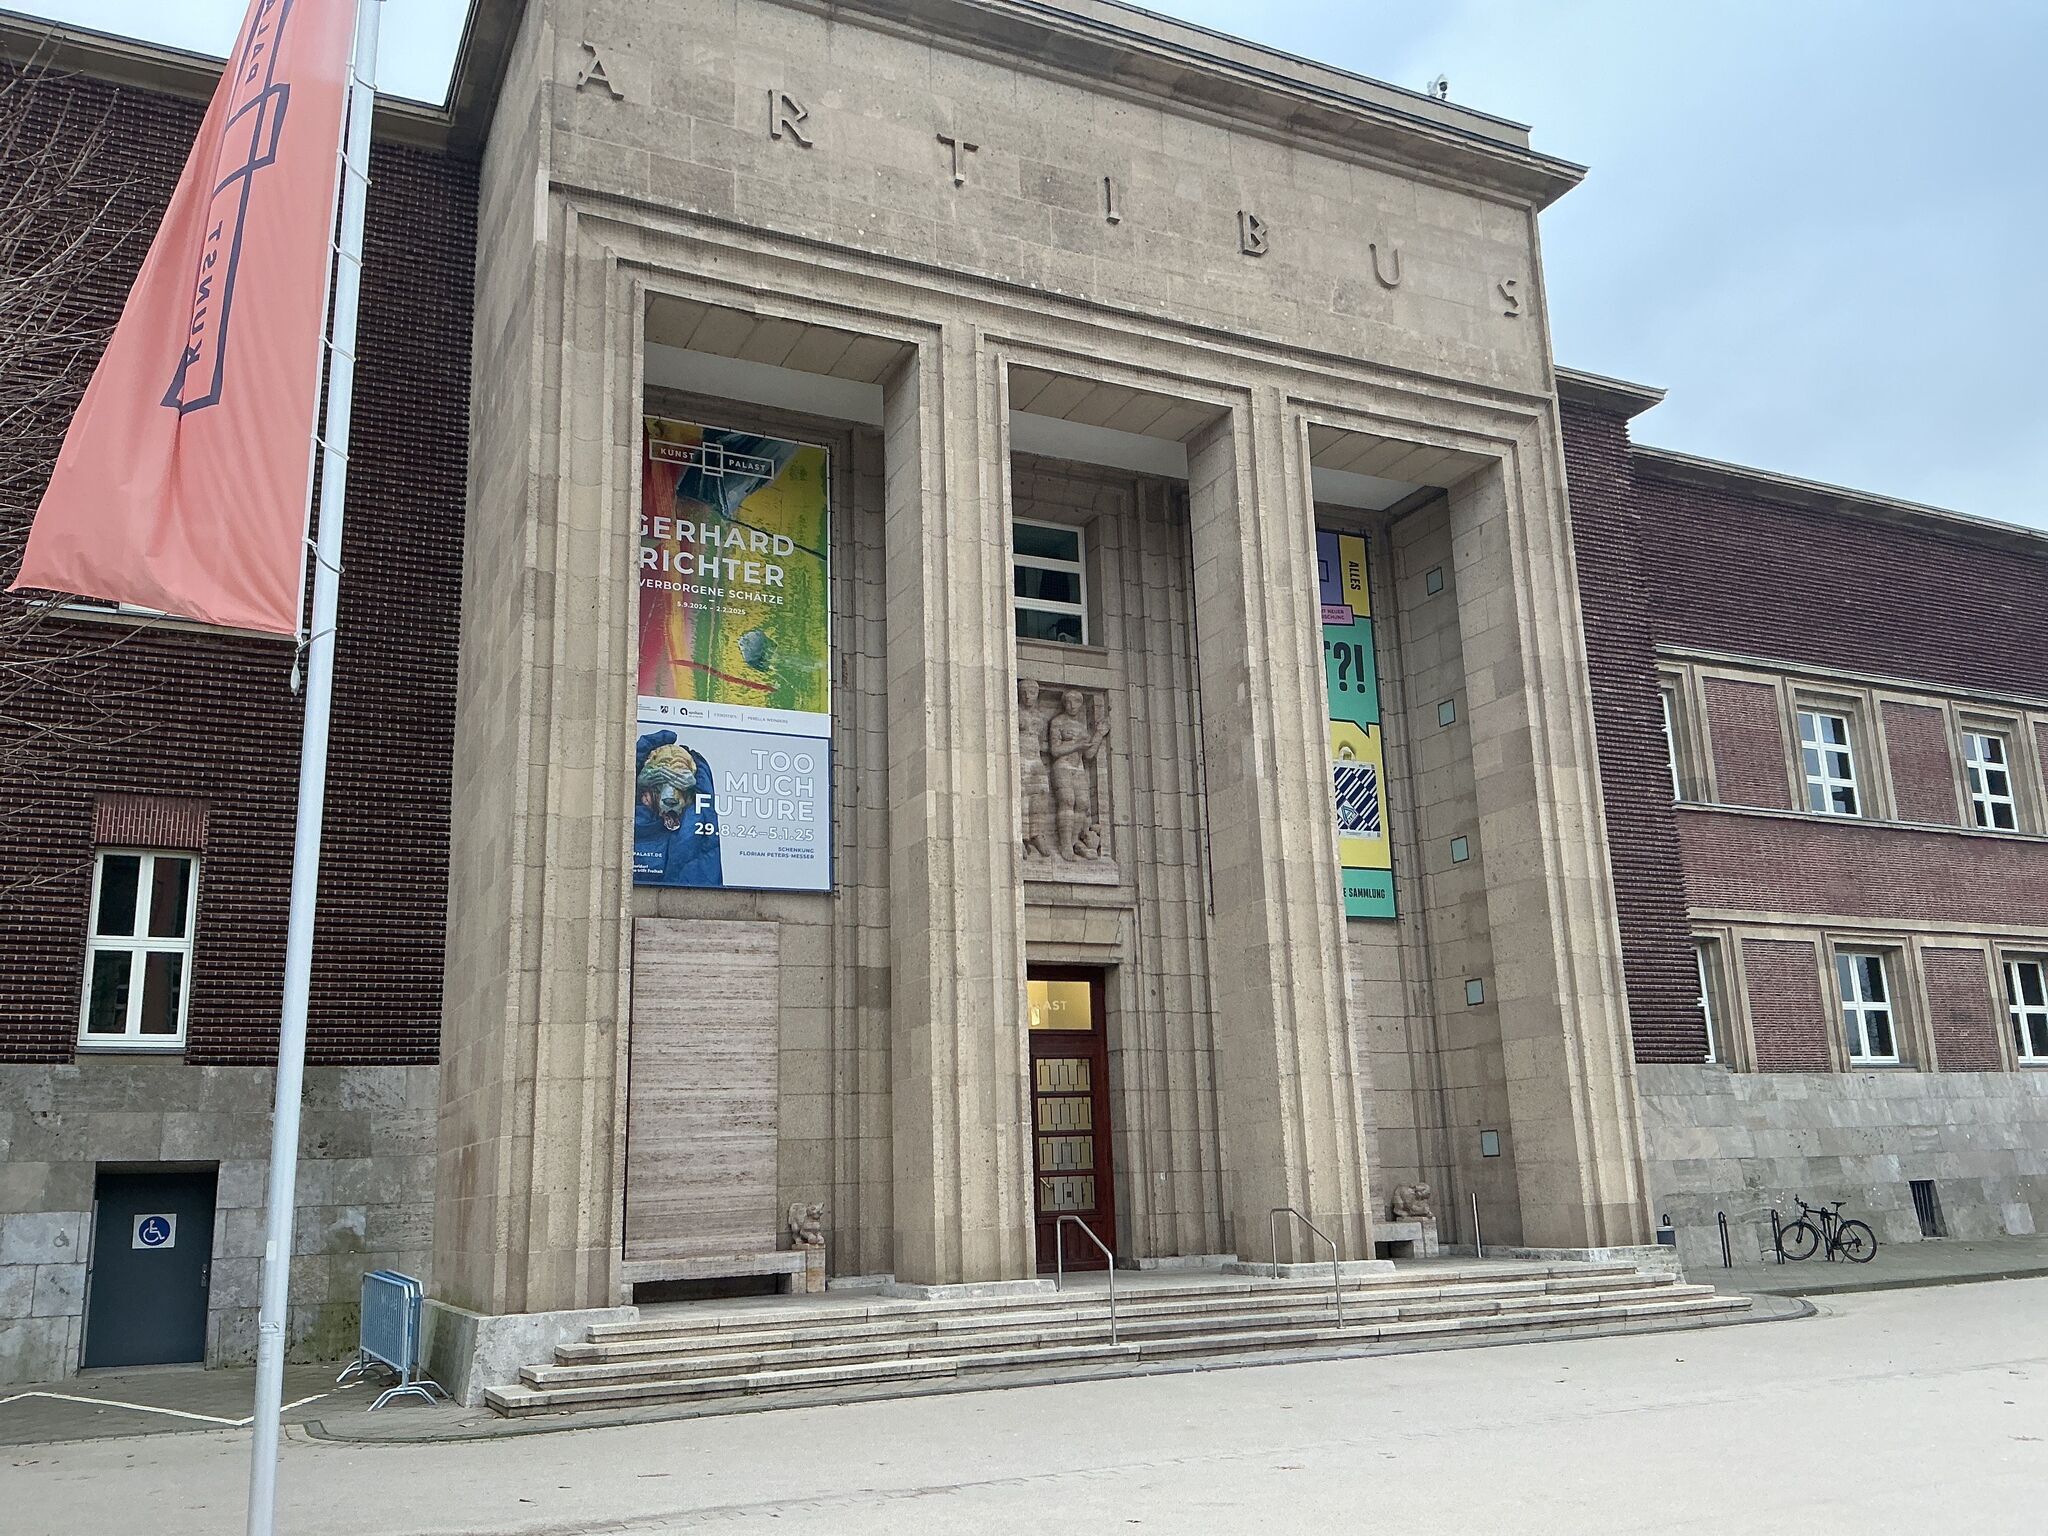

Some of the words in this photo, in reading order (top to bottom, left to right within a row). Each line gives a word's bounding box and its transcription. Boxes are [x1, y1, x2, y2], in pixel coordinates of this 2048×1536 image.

[577, 40, 1520, 318] ARTIBUS
[660, 447, 695, 460] KUNST
[729, 459, 766, 472] PALAST
[640, 546, 784, 588] RICHTER
[1349, 560, 1361, 591] ALLES
[640, 578, 724, 597] VERBORGENE
[729, 589, 783, 605] SCHÄTZE
[677, 601, 707, 610] 5.9.2024
[716, 606, 746, 615] 2.2.2025
[751, 749, 815, 774] TOO
[724, 771, 814, 798] MUCH
[695, 793, 815, 822] FUTURE
[1348, 887, 1386, 899] SAMMLUNG
